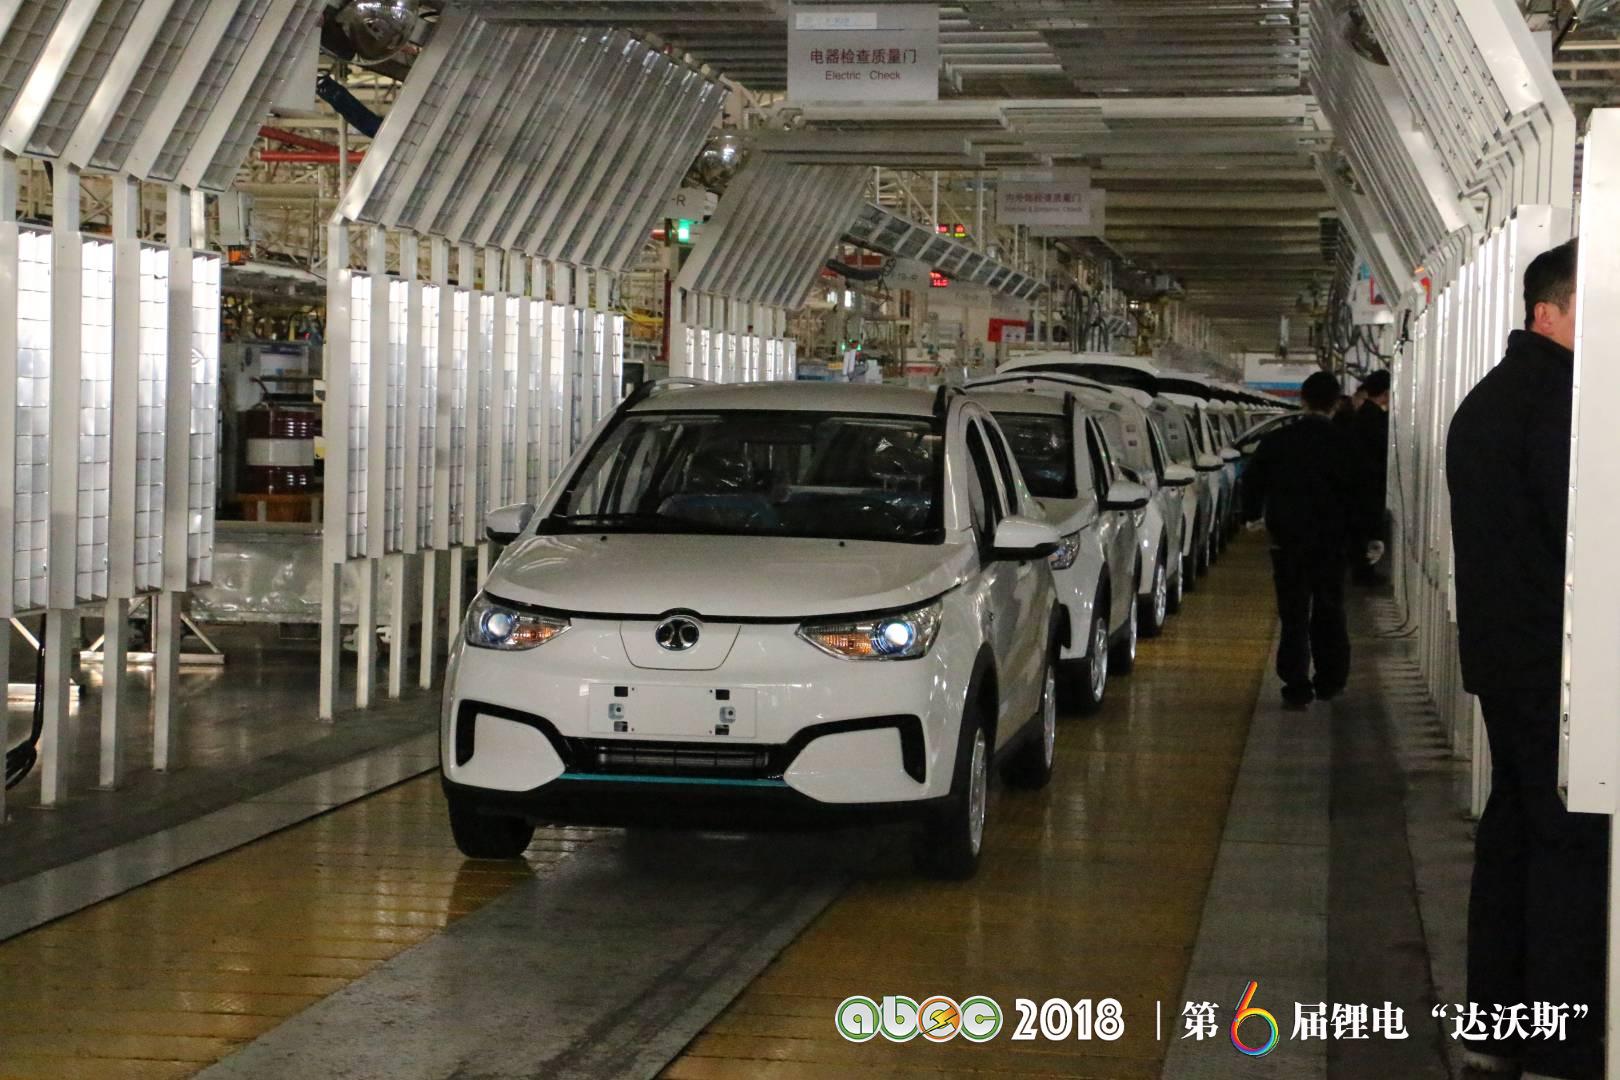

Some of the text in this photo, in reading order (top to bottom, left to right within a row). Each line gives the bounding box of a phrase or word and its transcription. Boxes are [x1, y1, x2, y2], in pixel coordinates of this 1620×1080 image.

[810, 48, 917, 64] 电器检查质量门
[825, 70, 901, 80] Electric Check
